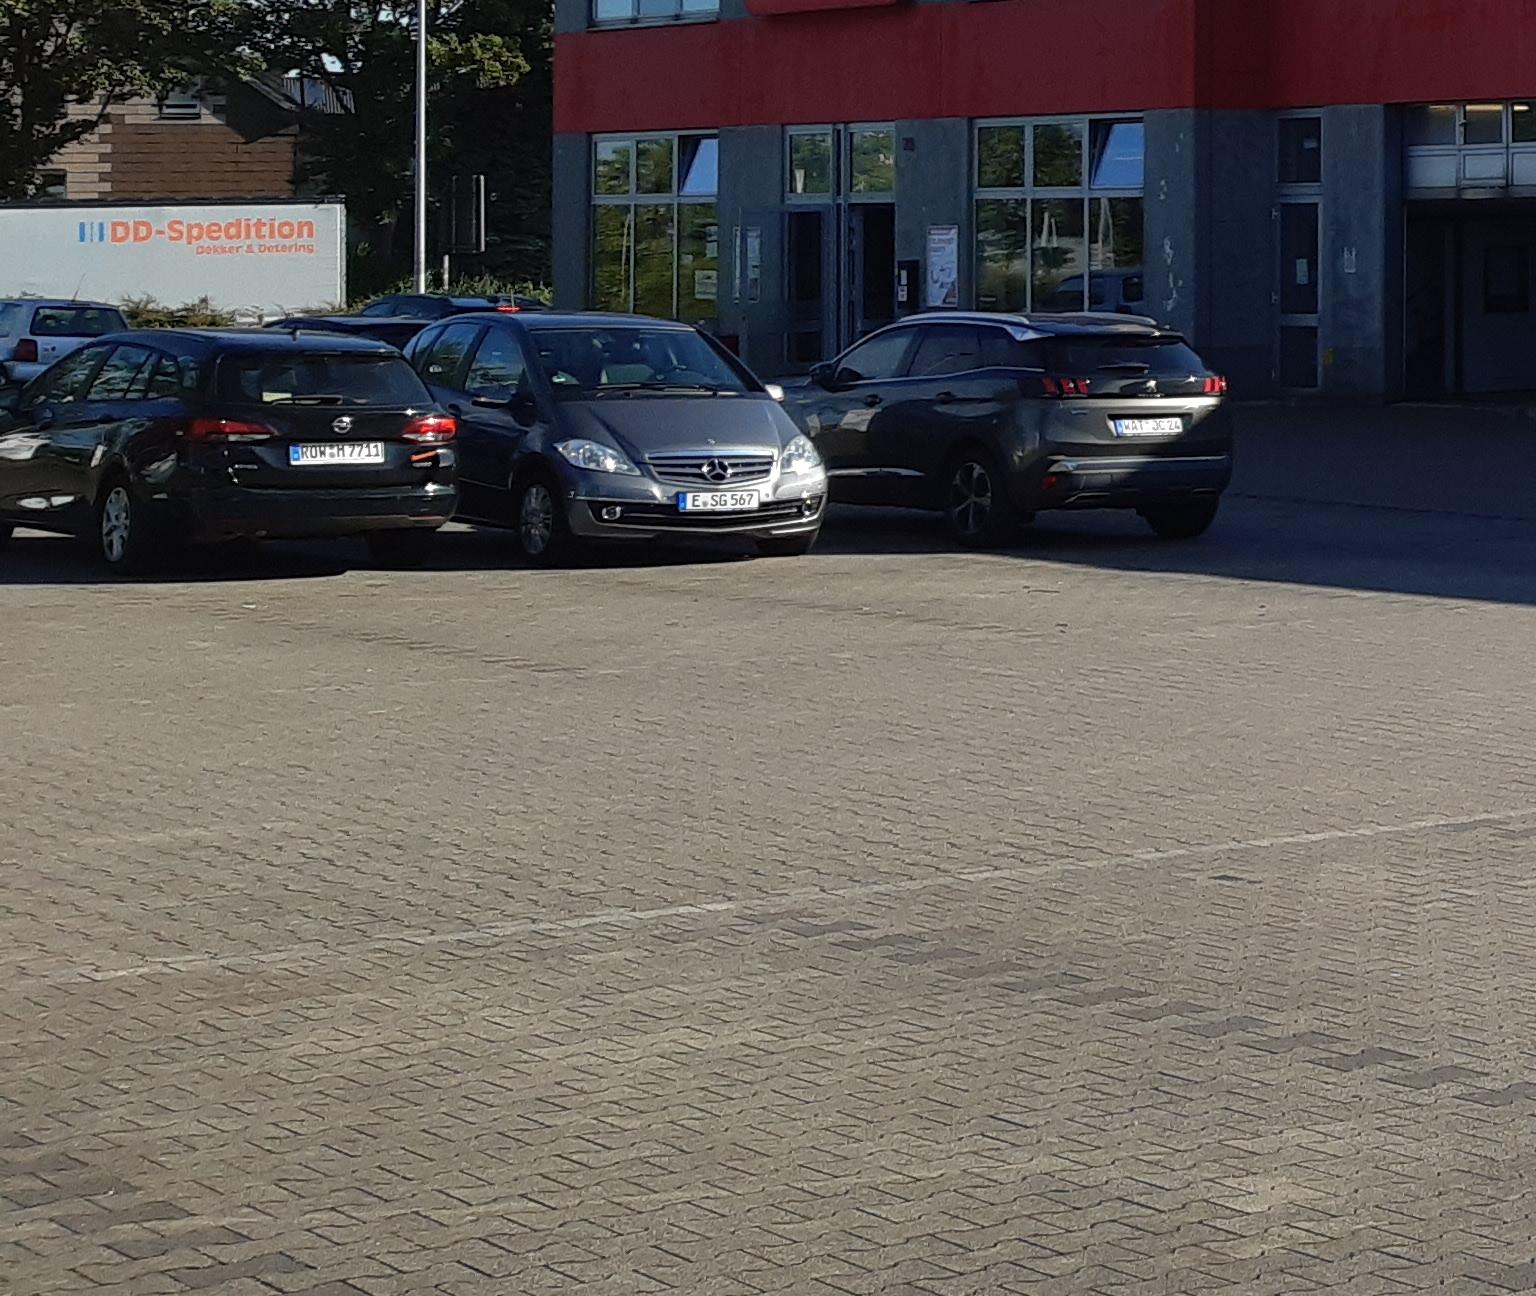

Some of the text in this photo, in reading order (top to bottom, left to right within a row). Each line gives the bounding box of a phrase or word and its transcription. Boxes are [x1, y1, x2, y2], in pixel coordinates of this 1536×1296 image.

[110, 219, 315, 245] DD-Spedition
[302, 443, 380, 459] ROW H 7711
[692, 493, 753, 507] E SG 567
